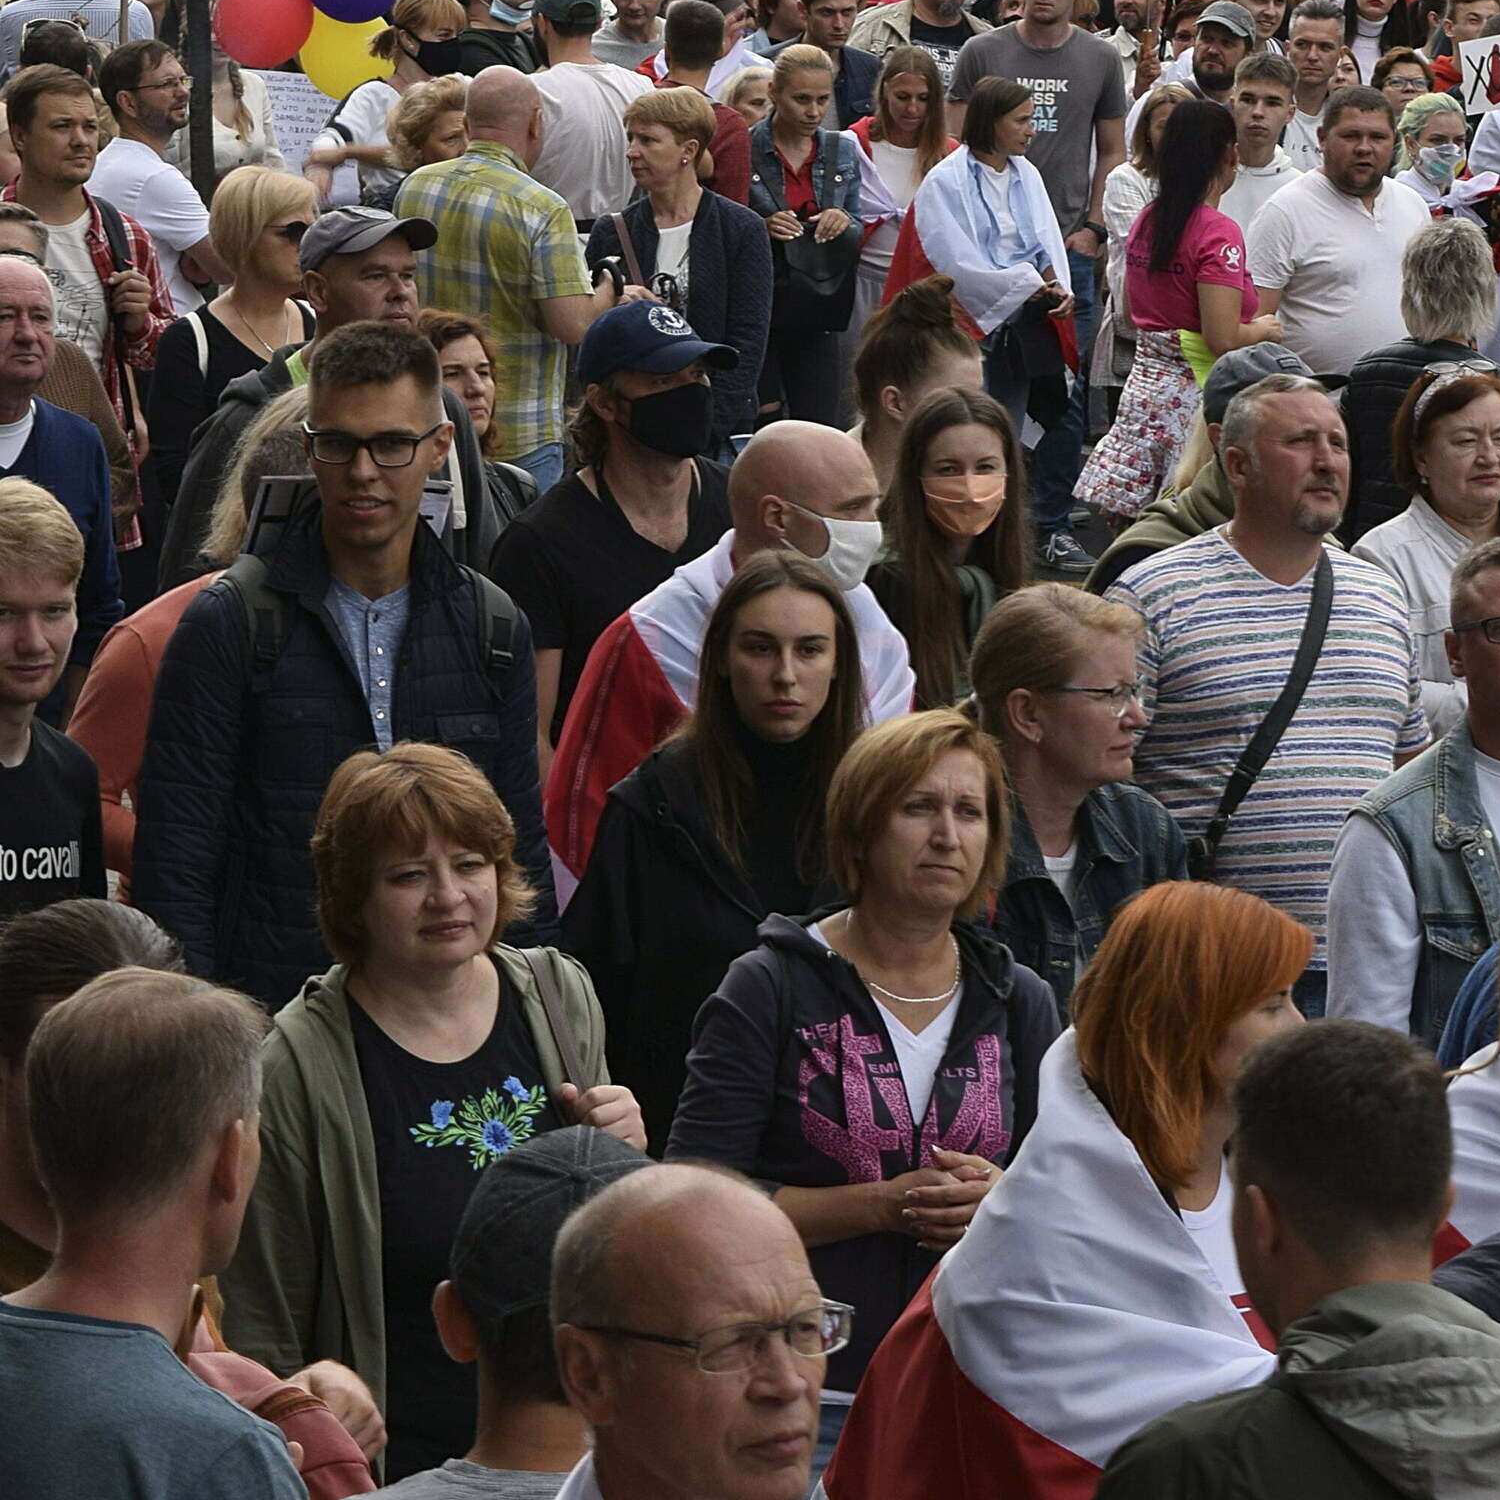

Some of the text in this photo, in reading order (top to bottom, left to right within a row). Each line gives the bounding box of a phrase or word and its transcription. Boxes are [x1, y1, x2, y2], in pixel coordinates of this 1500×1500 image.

[1017, 77, 1069, 93] WORK
[1032, 92, 1056, 105] SS
[1033, 106, 1058, 119] AY
